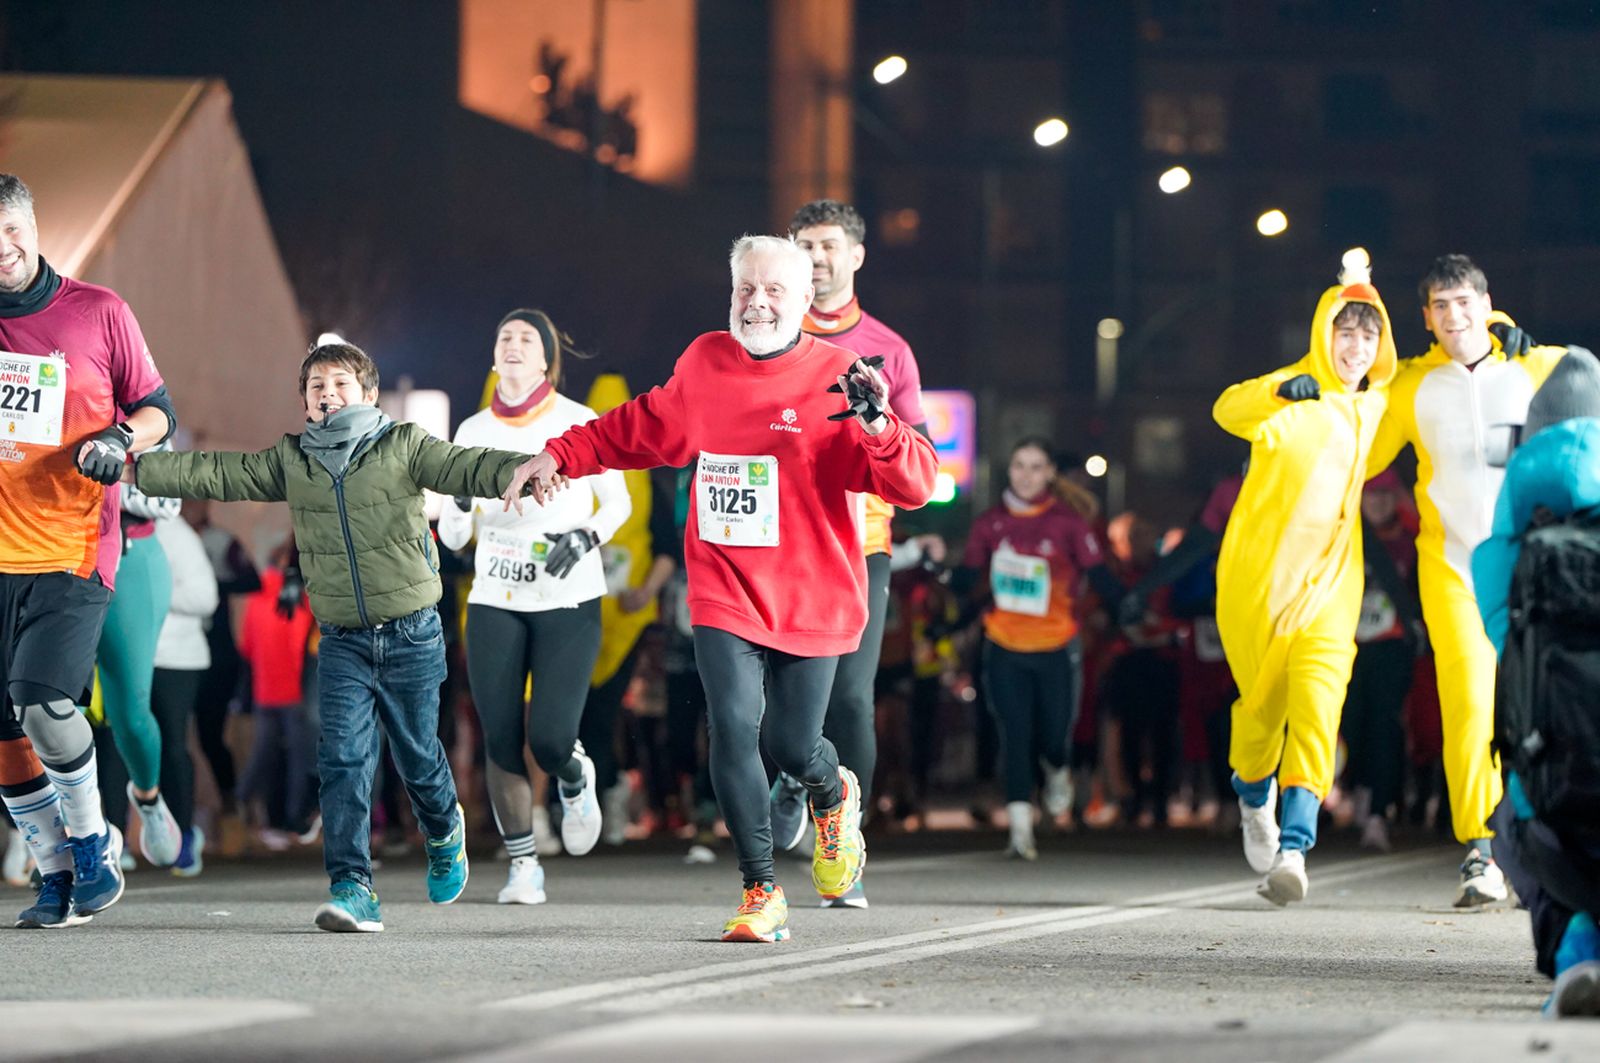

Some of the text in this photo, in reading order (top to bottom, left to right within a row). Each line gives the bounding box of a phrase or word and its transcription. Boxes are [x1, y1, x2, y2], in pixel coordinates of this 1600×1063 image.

[20, 365, 31, 373] DE
[0, 384, 42, 413] 221
[728, 465, 740, 474] DE
[709, 485, 757, 515] 3125
[488, 556, 537, 583] 2693
